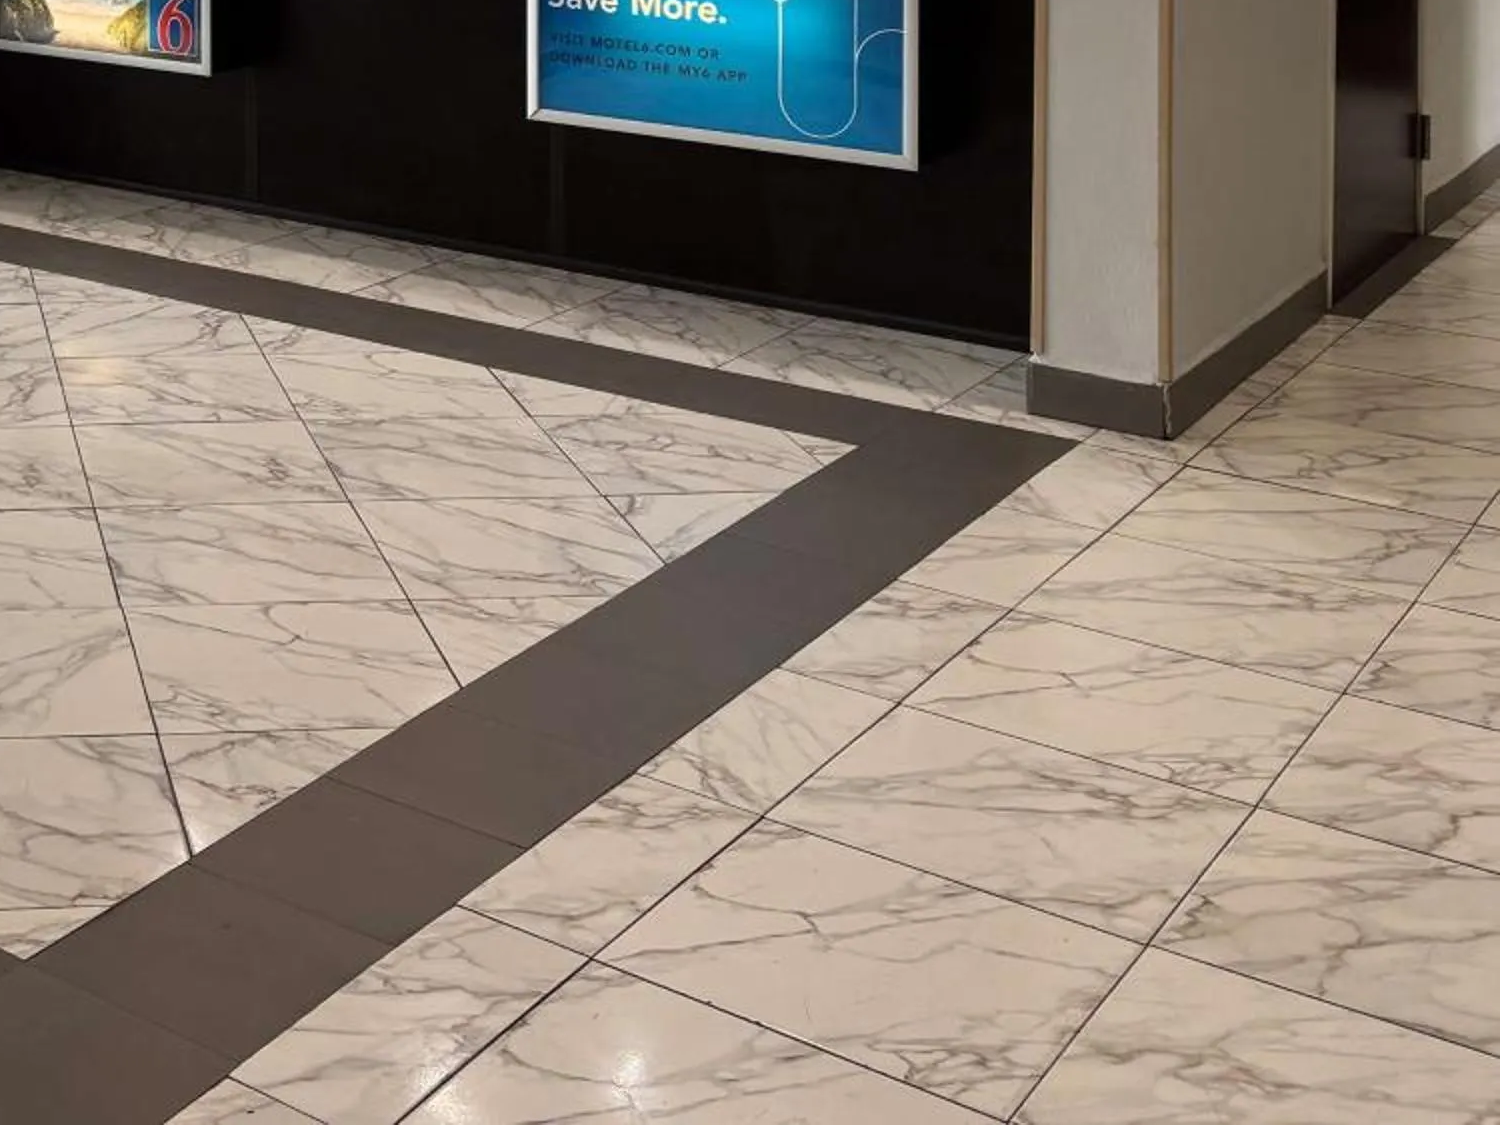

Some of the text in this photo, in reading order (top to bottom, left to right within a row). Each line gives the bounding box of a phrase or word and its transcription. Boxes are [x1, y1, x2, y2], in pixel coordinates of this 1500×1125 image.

[551, 32, 720, 61] VISIT MOTEL6.COM OR
[550, 51, 747, 83] DOWNLOAD THE MY6 APP
